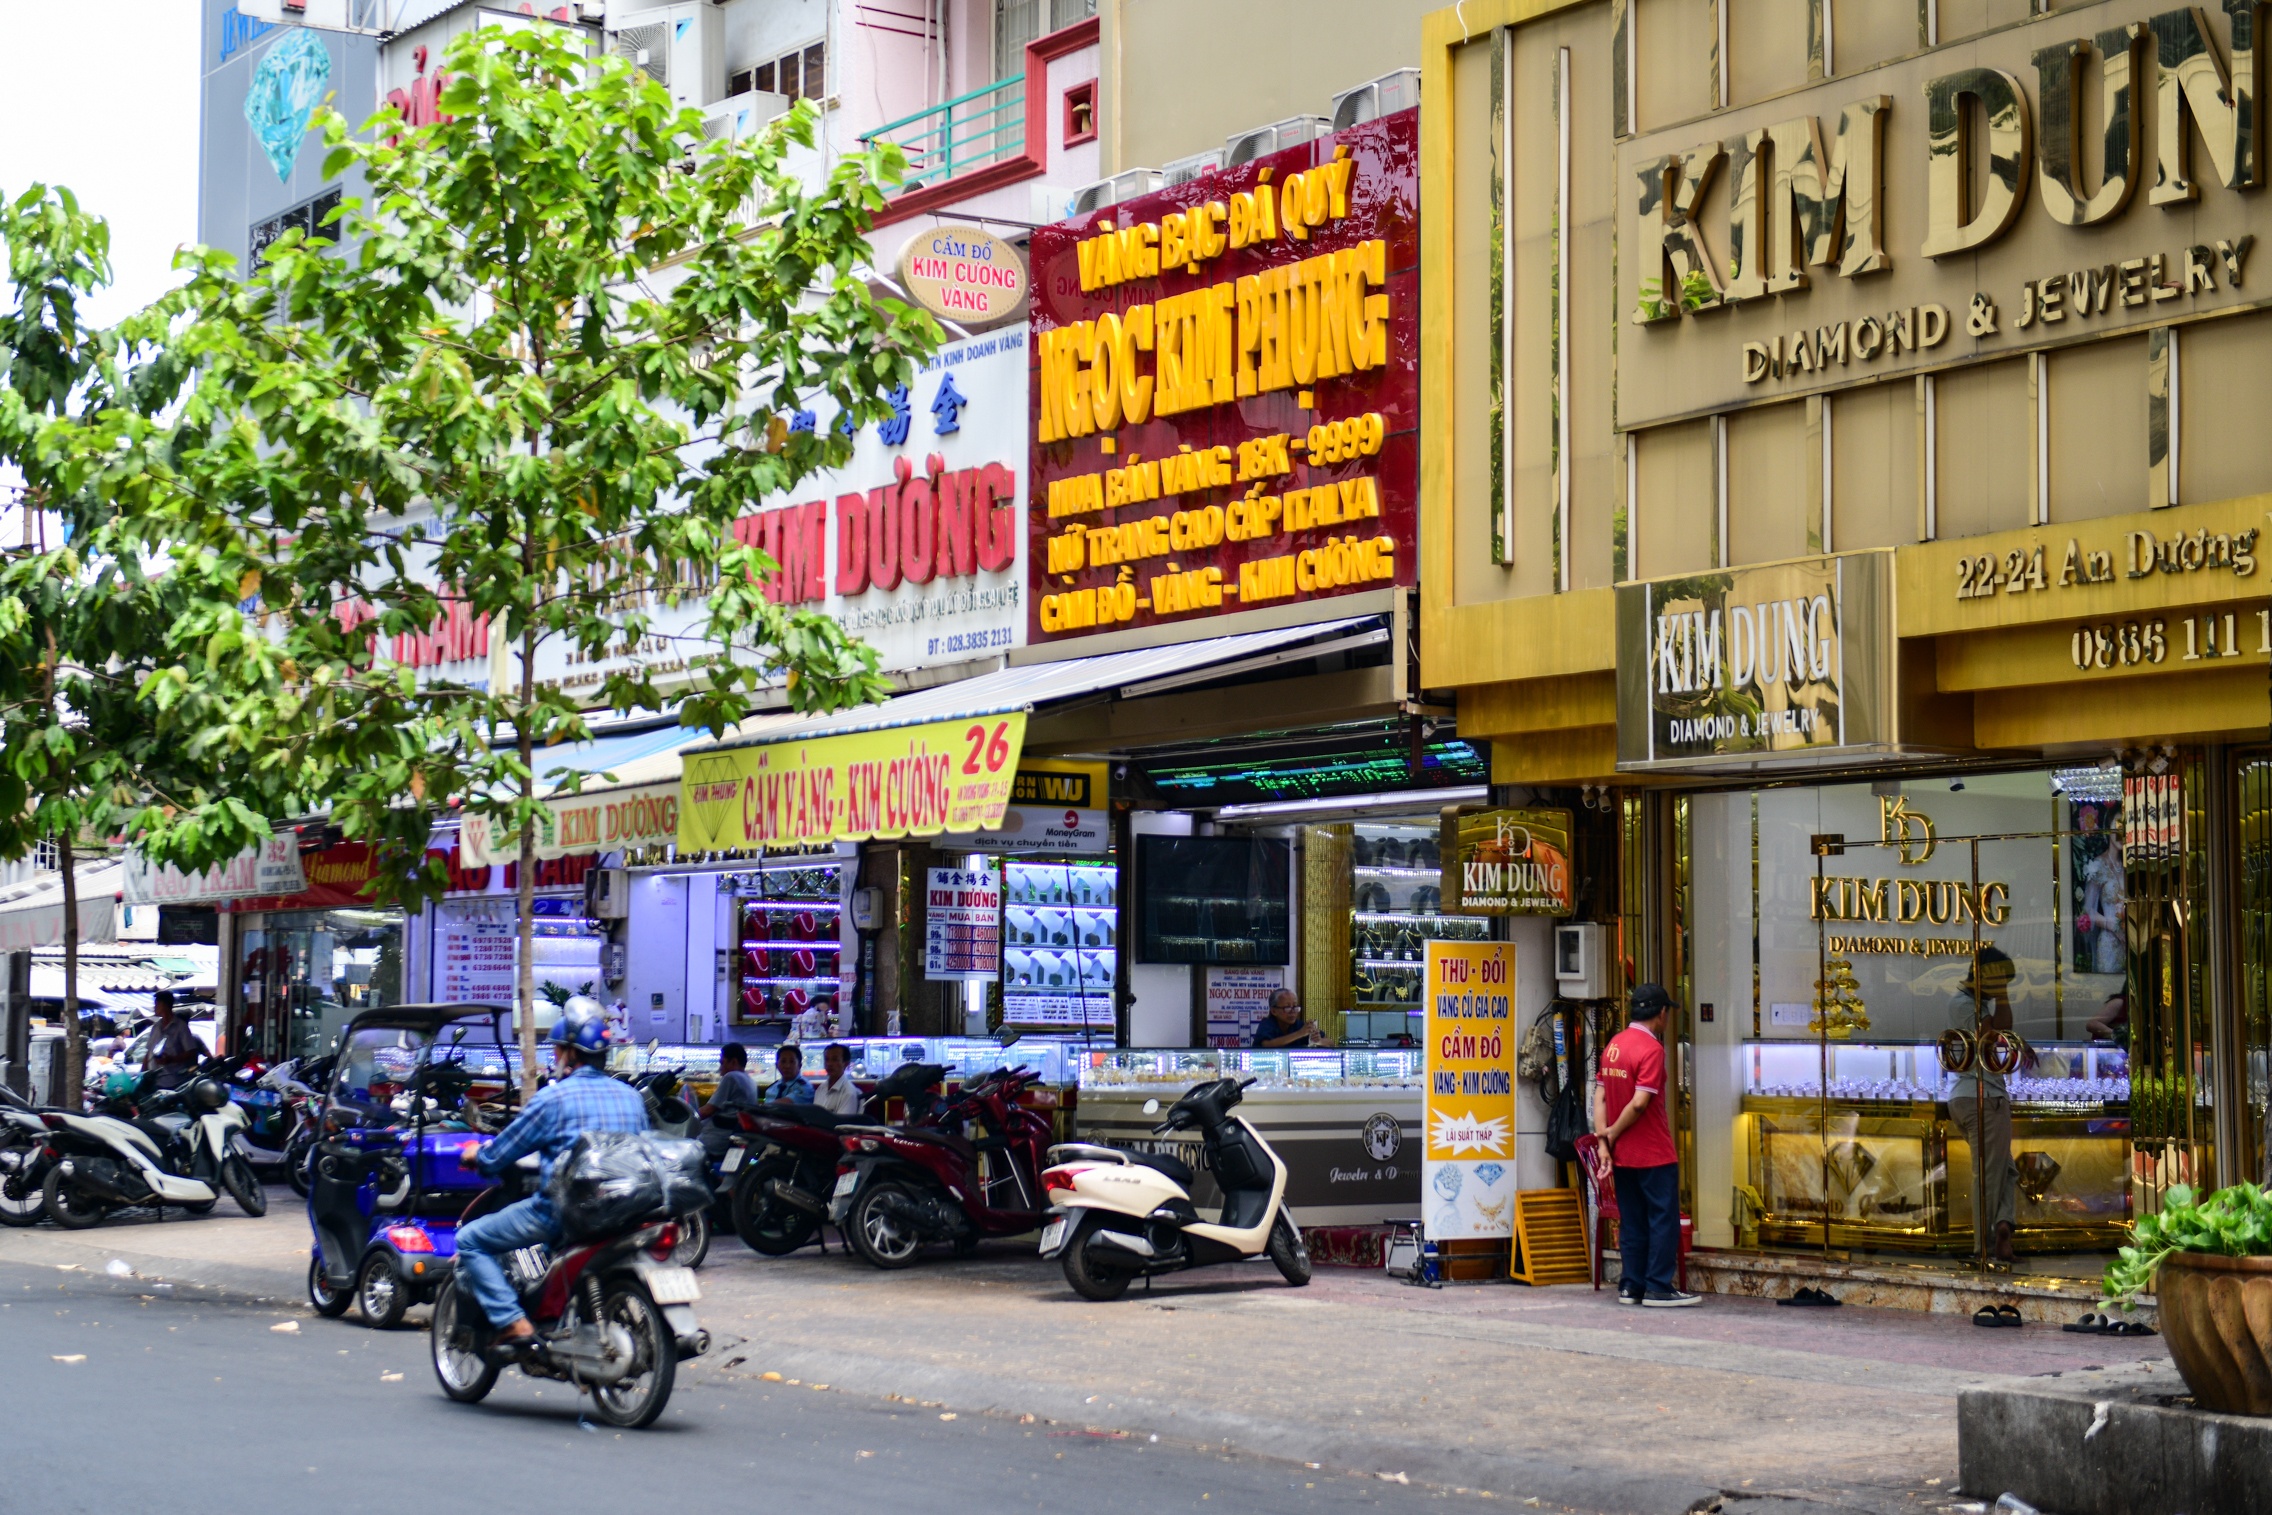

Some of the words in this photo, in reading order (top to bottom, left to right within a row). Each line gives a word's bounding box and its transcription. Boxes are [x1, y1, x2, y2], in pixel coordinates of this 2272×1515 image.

[1077, 220, 1158, 291] VÀNG
[1162, 201, 1226, 274] BẠC
[1230, 167, 1277, 249] ĐÁ
[1281, 145, 1351, 240] QUÝ
[1631, 94, 1892, 327] KIM
[932, 235, 966, 257] CẦM
[971, 240, 992, 260] ĐỒ
[912, 256, 947, 280] KIM
[954, 261, 1015, 289] CƯƠNG
[940, 284, 988, 312] VÀNG
[1742, 302, 1949, 384] DIAMOND
[1966, 291, 1998, 340] &
[2014, 235, 2255, 330] JEWELRY
[944, 349, 964, 368] KINH
[967, 339, 997, 361] DOANH
[999, 331, 1023, 352] VÀNG
[1038, 304, 1153, 454] NGỌC
[1154, 282, 1234, 417] KIM
[1236, 239, 1389, 409] PHỤNG
[1048, 473, 1104, 518] MUA
[1105, 453, 1159, 507] BÁN
[1160, 444, 1231, 496] VÀNG
[1236, 433, 1291, 482] 18K
[1307, 412, 1384, 467] 9999
[733, 499, 826, 606] KIM
[835, 452, 1015, 597] DƯƠNG
[1086, 515, 1170, 567] TRANG
[1170, 505, 1224, 551] CAO
[1225, 481, 1282, 542] CẤP
[1283, 476, 1380, 532] ITALYA
[1097, 565, 1137, 624] ĐỒ
[1150, 562, 1222, 614] VÀNG
[1239, 555, 1296, 602] KIM
[1296, 535, 1394, 591] CƯƠNG
[1955, 544, 2048, 602] 22-24
[2057, 538, 2115, 587] An
[2125, 526, 2260, 579] Dương
[947, 630, 988, 654] 028.3835
[990, 627, 1013, 648] 2131
[1657, 609, 1723, 694] KIM
[1730, 595, 1830, 687] DUNG
[2071, 618, 2167, 671] 0886
[2182, 611, 2242, 661] 111
[1670, 715, 1735, 743] DIAMOND
[1740, 714, 1751, 738] &
[1754, 708, 1820, 739] JEWELRY
[961, 721, 1009, 775] 26
[784, 748, 834, 838] VÀNG
[847, 759, 883, 834] KIM
[886, 738, 950, 830] CƯƠNG
[1043, 776, 1086, 801] WU
[559, 806, 601, 848] KIM
[605, 793, 680, 843] DƯƠNG
[1045, 828, 1096, 839] MoneyGram
[974, 837, 998, 848] dịch
[1000, 839, 1014, 848] vụ
[1014, 837, 1055, 849] chuyển
[1058, 839, 1078, 849] tiền
[1463, 862, 1502, 892] KIM
[1507, 863, 1562, 893] DUNG
[929, 890, 953, 907] KIM
[957, 888, 998, 908] DƯƠNG
[1461, 897, 1508, 907] DIAMOND
[1511, 898, 1518, 907] &
[1520, 898, 1564, 907] JEWELRY
[1810, 876, 1891, 922] KIM
[1896, 878, 2012, 927] DUNG
[949, 913, 971, 922] MUA
[975, 912, 994, 922] BÁN
[1828, 936, 1907, 955] DIAMOND
[1909, 937, 1924, 955] &
[1440, 958, 1468, 984] THU
[1481, 946, 1506, 984] ĐỔI
[1209, 988, 1233, 1001] NGỌC
[1234, 989, 1250, 999] KIM
[1436, 988, 1458, 1018] VÀNG
[1461, 988, 1473, 1018] CŨ
[1475, 988, 1489, 1019] GIÁ
[1491, 995, 1508, 1018] CAO
[1441, 1025, 1475, 1060] CẦM
[1480, 1025, 1501, 1060] ĐỒ
[1433, 1066, 1456, 1095] VÀNG
[1462, 1071, 1479, 1095] KIM
[1481, 1067, 1510, 1096] CƯƠNG
